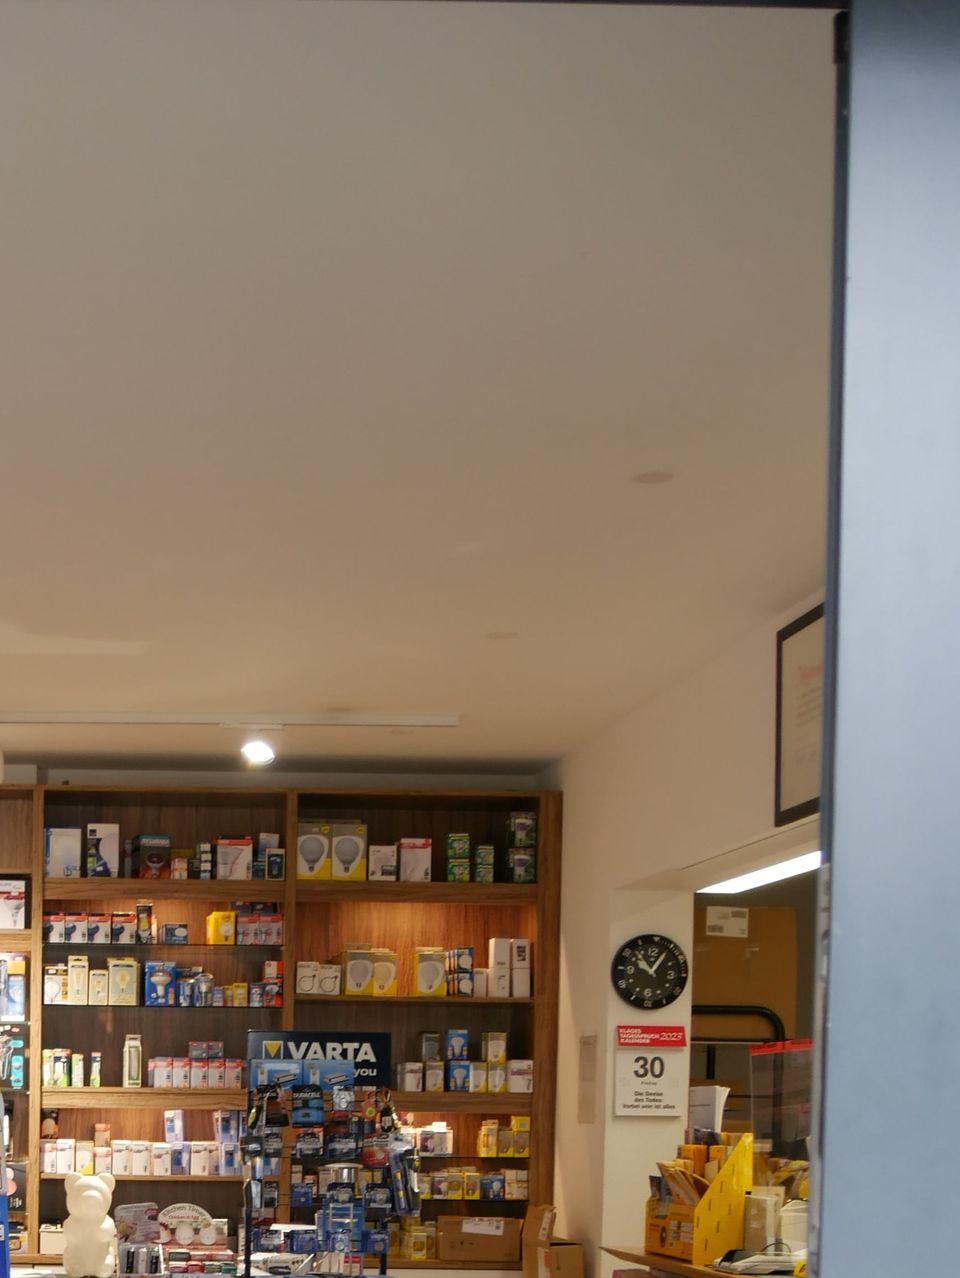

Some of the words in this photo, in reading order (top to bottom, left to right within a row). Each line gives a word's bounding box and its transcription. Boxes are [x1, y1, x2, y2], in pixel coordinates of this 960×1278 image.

[648, 947, 658, 956] 12
[626, 966, 634, 974] 9
[666, 970, 675, 980] 3
[644, 988, 652, 997] 6
[288, 1041, 377, 1062] VARTA
[634, 1056, 665, 1078] 30
[353, 1068, 378, 1078] you
